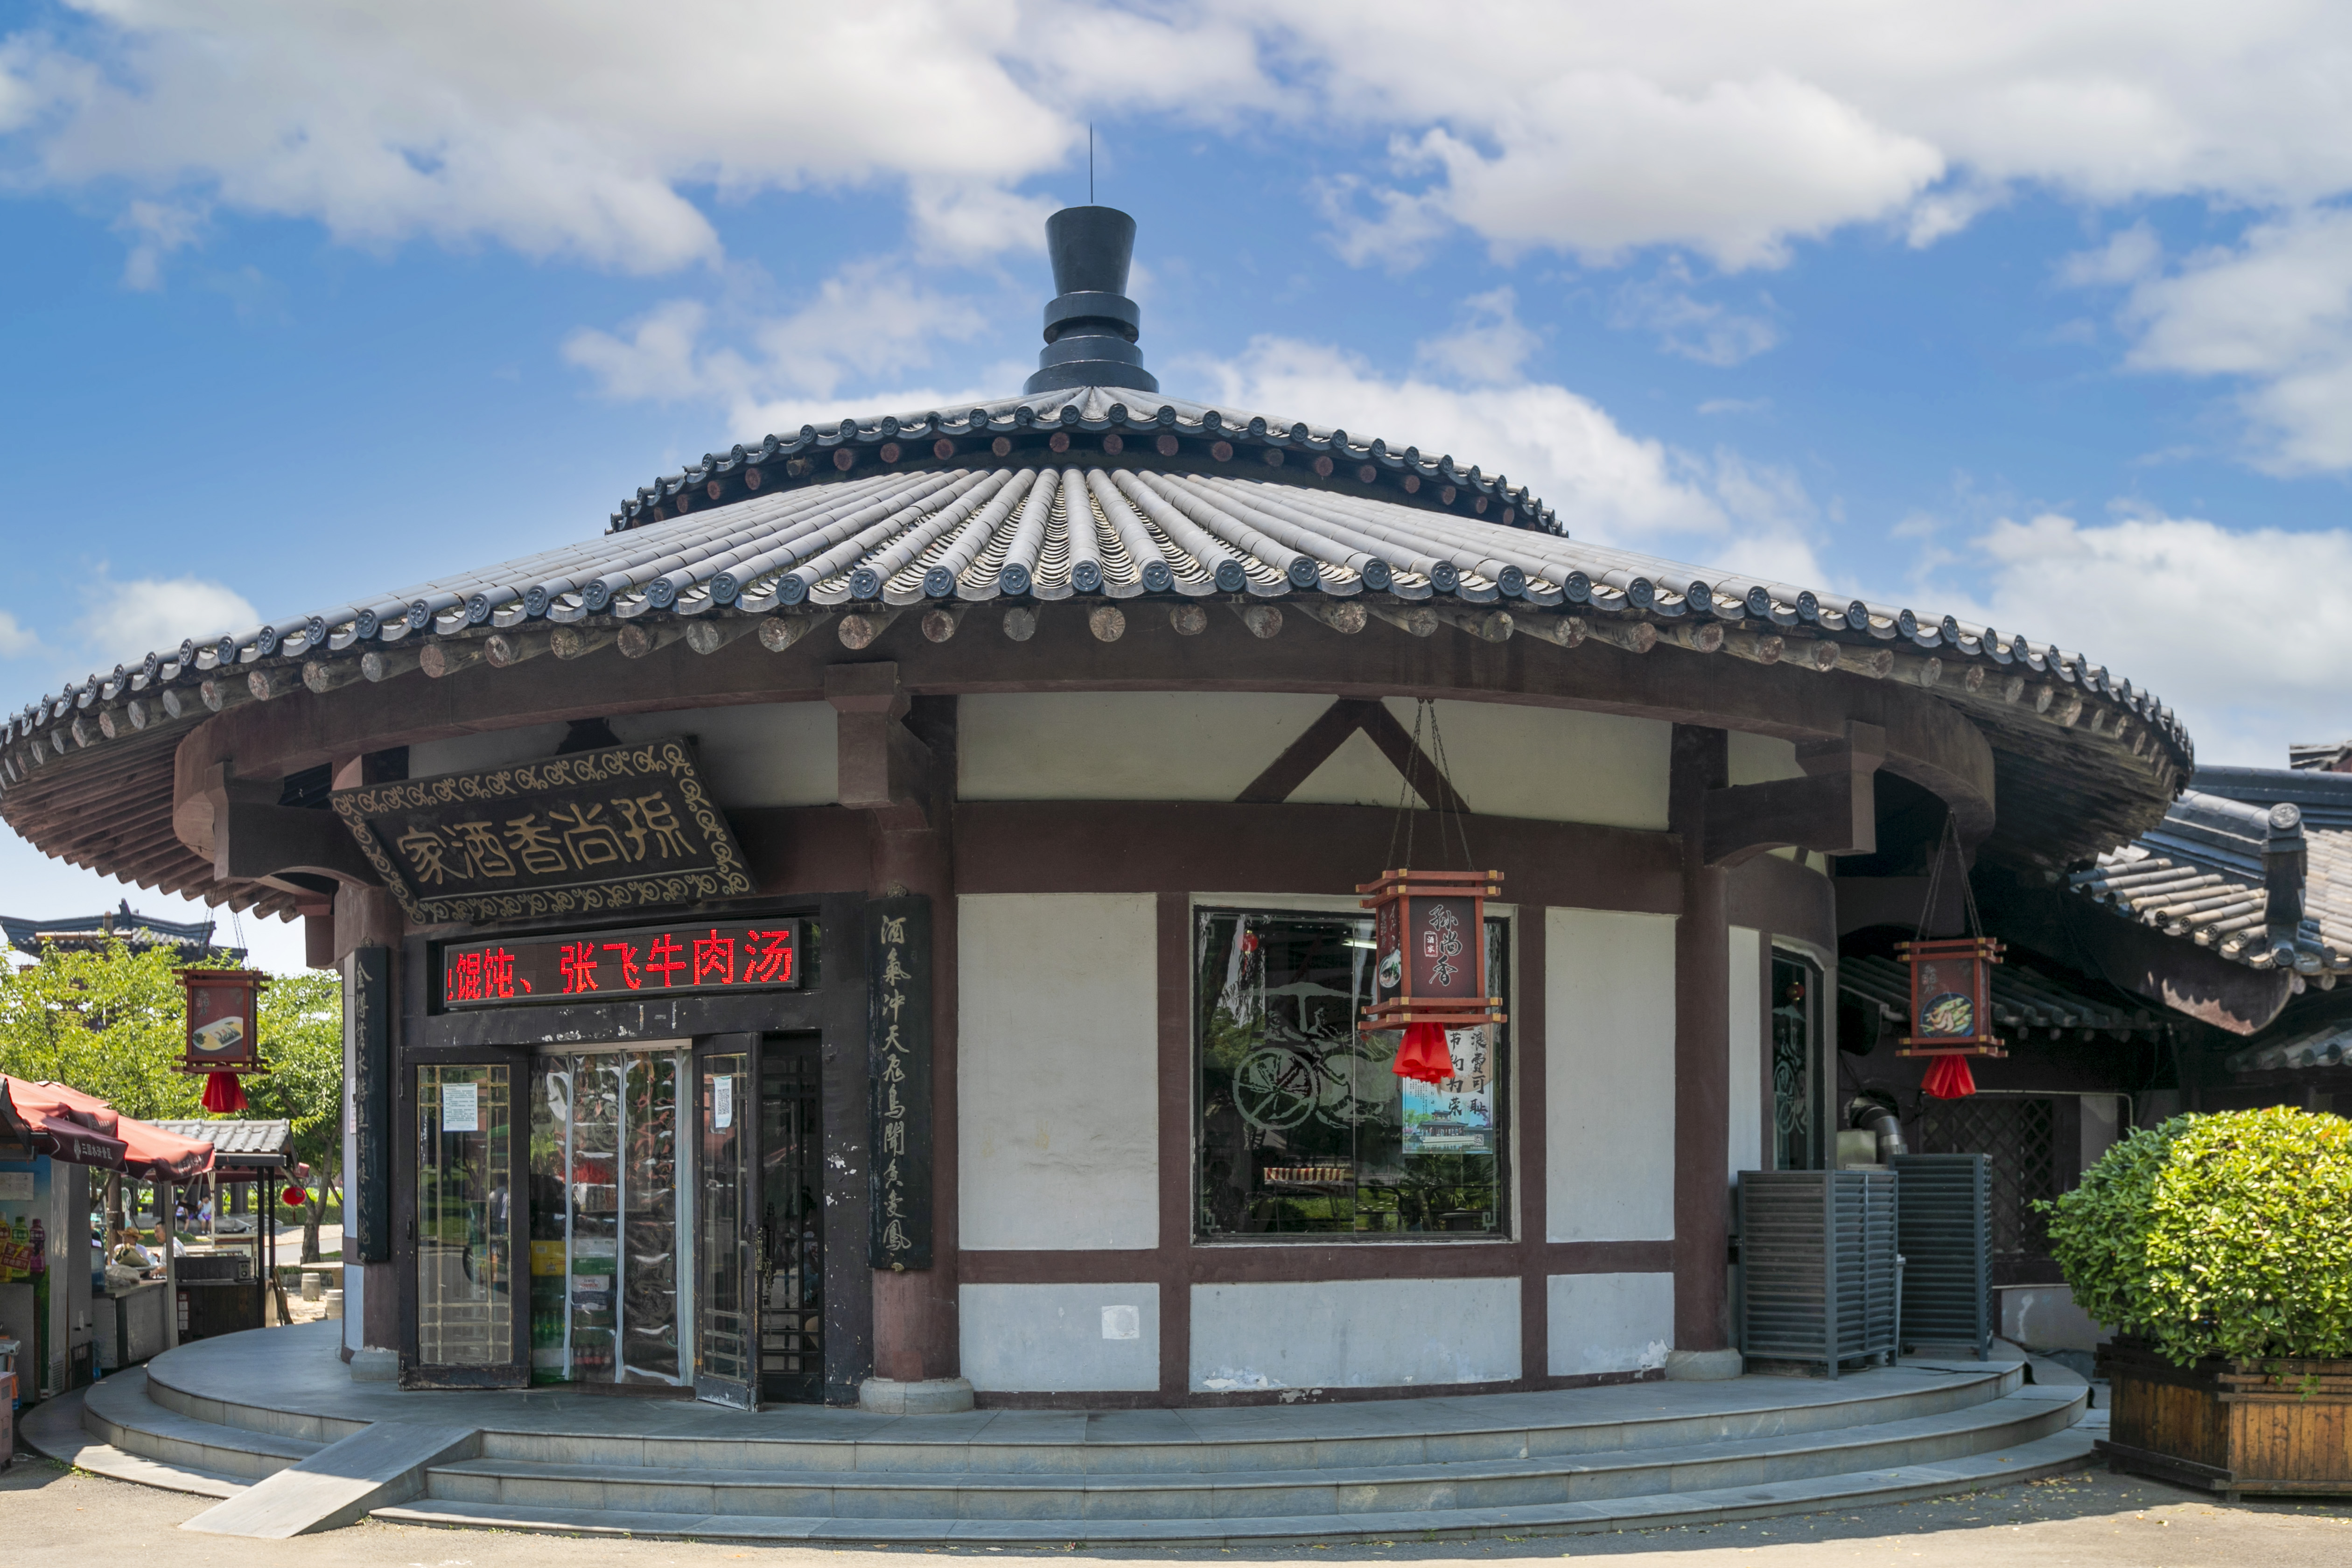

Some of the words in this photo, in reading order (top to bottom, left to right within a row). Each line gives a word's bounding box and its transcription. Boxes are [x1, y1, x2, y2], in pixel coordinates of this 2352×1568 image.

[448, 929, 792, 1001] 馄饨、张飞牛肉汤
[1427, 936, 1435, 953] 酒家
[1429, 904, 1463, 987] 孙尚香
[1446, 1032, 1464, 1117] 节约为荣
[1470, 1031, 1488, 1115] 浪费可耻
